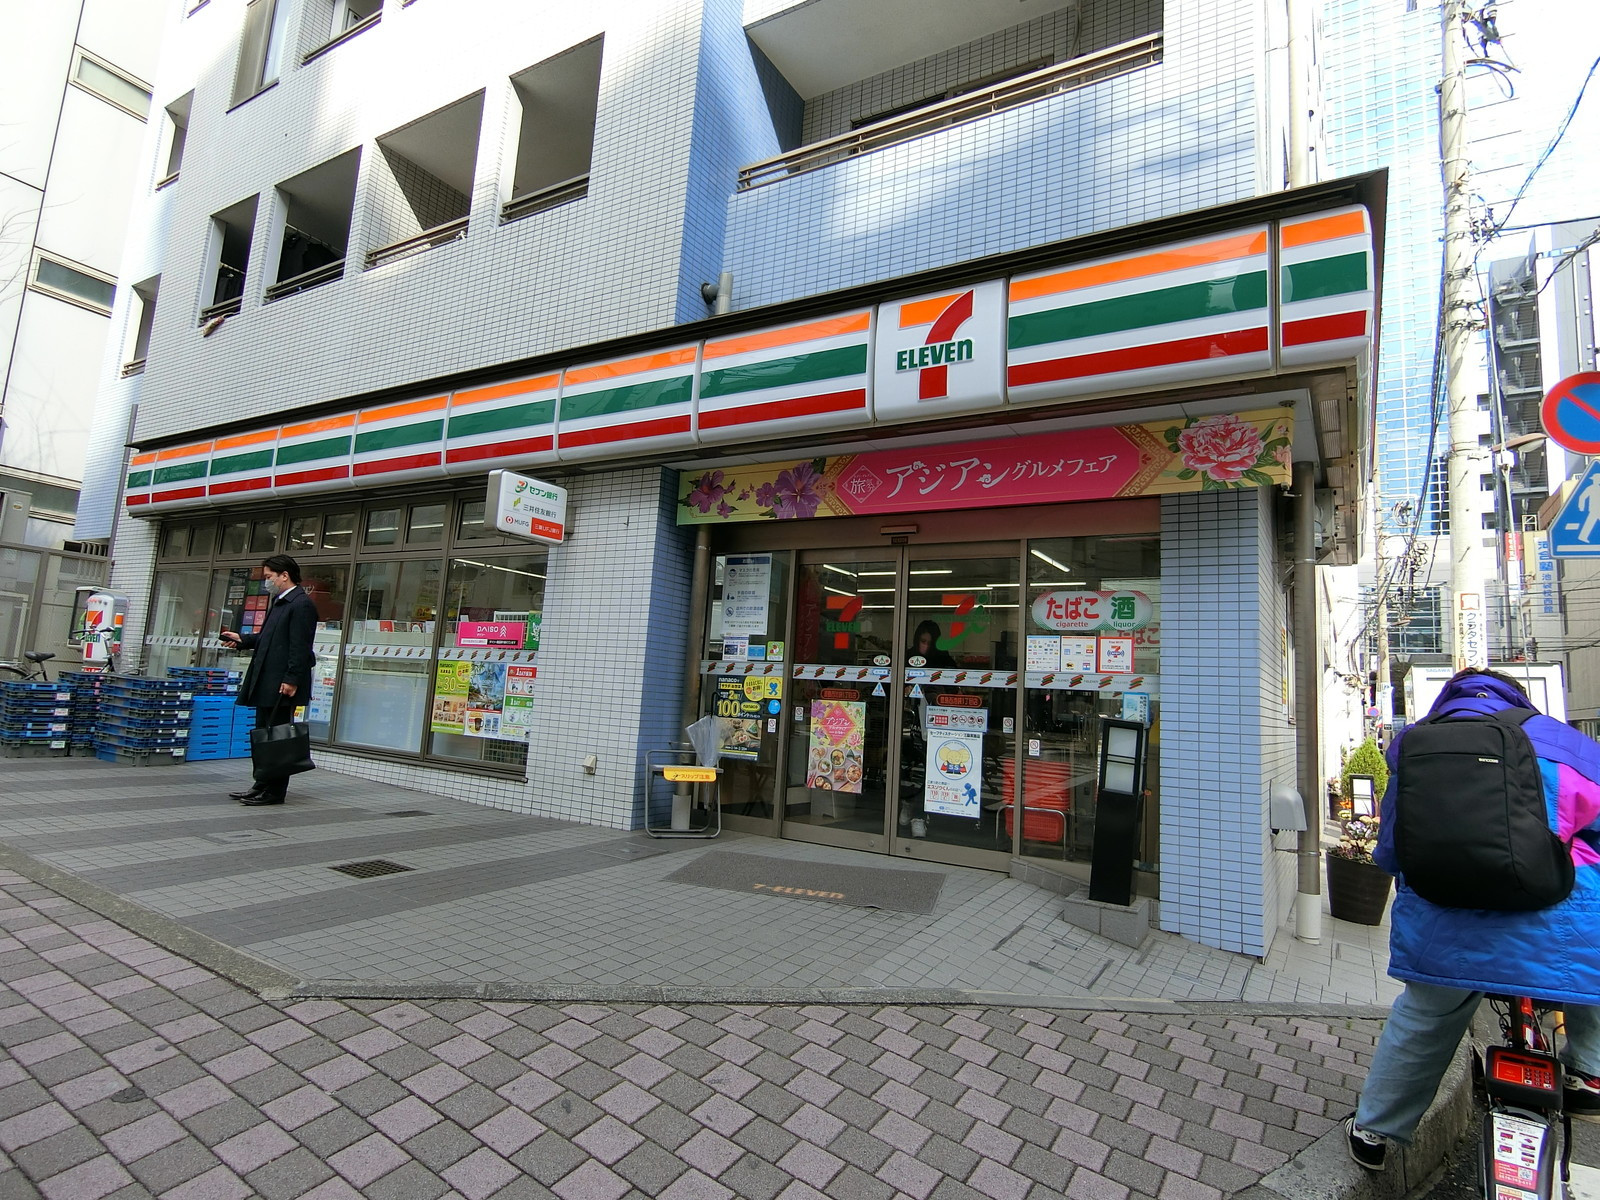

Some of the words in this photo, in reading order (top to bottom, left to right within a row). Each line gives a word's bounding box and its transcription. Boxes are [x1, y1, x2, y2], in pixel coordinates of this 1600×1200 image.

[529, 485, 558, 501] セブン銀行
[523, 503, 557, 519] 三井住友銀行
[514, 518, 530, 528] MUFG
[1046, 596, 1100, 620] たばこ
[1110, 596, 1136, 620] 酒
[476, 625, 499, 633] DAISO
[717, 699, 740, 717] 100
